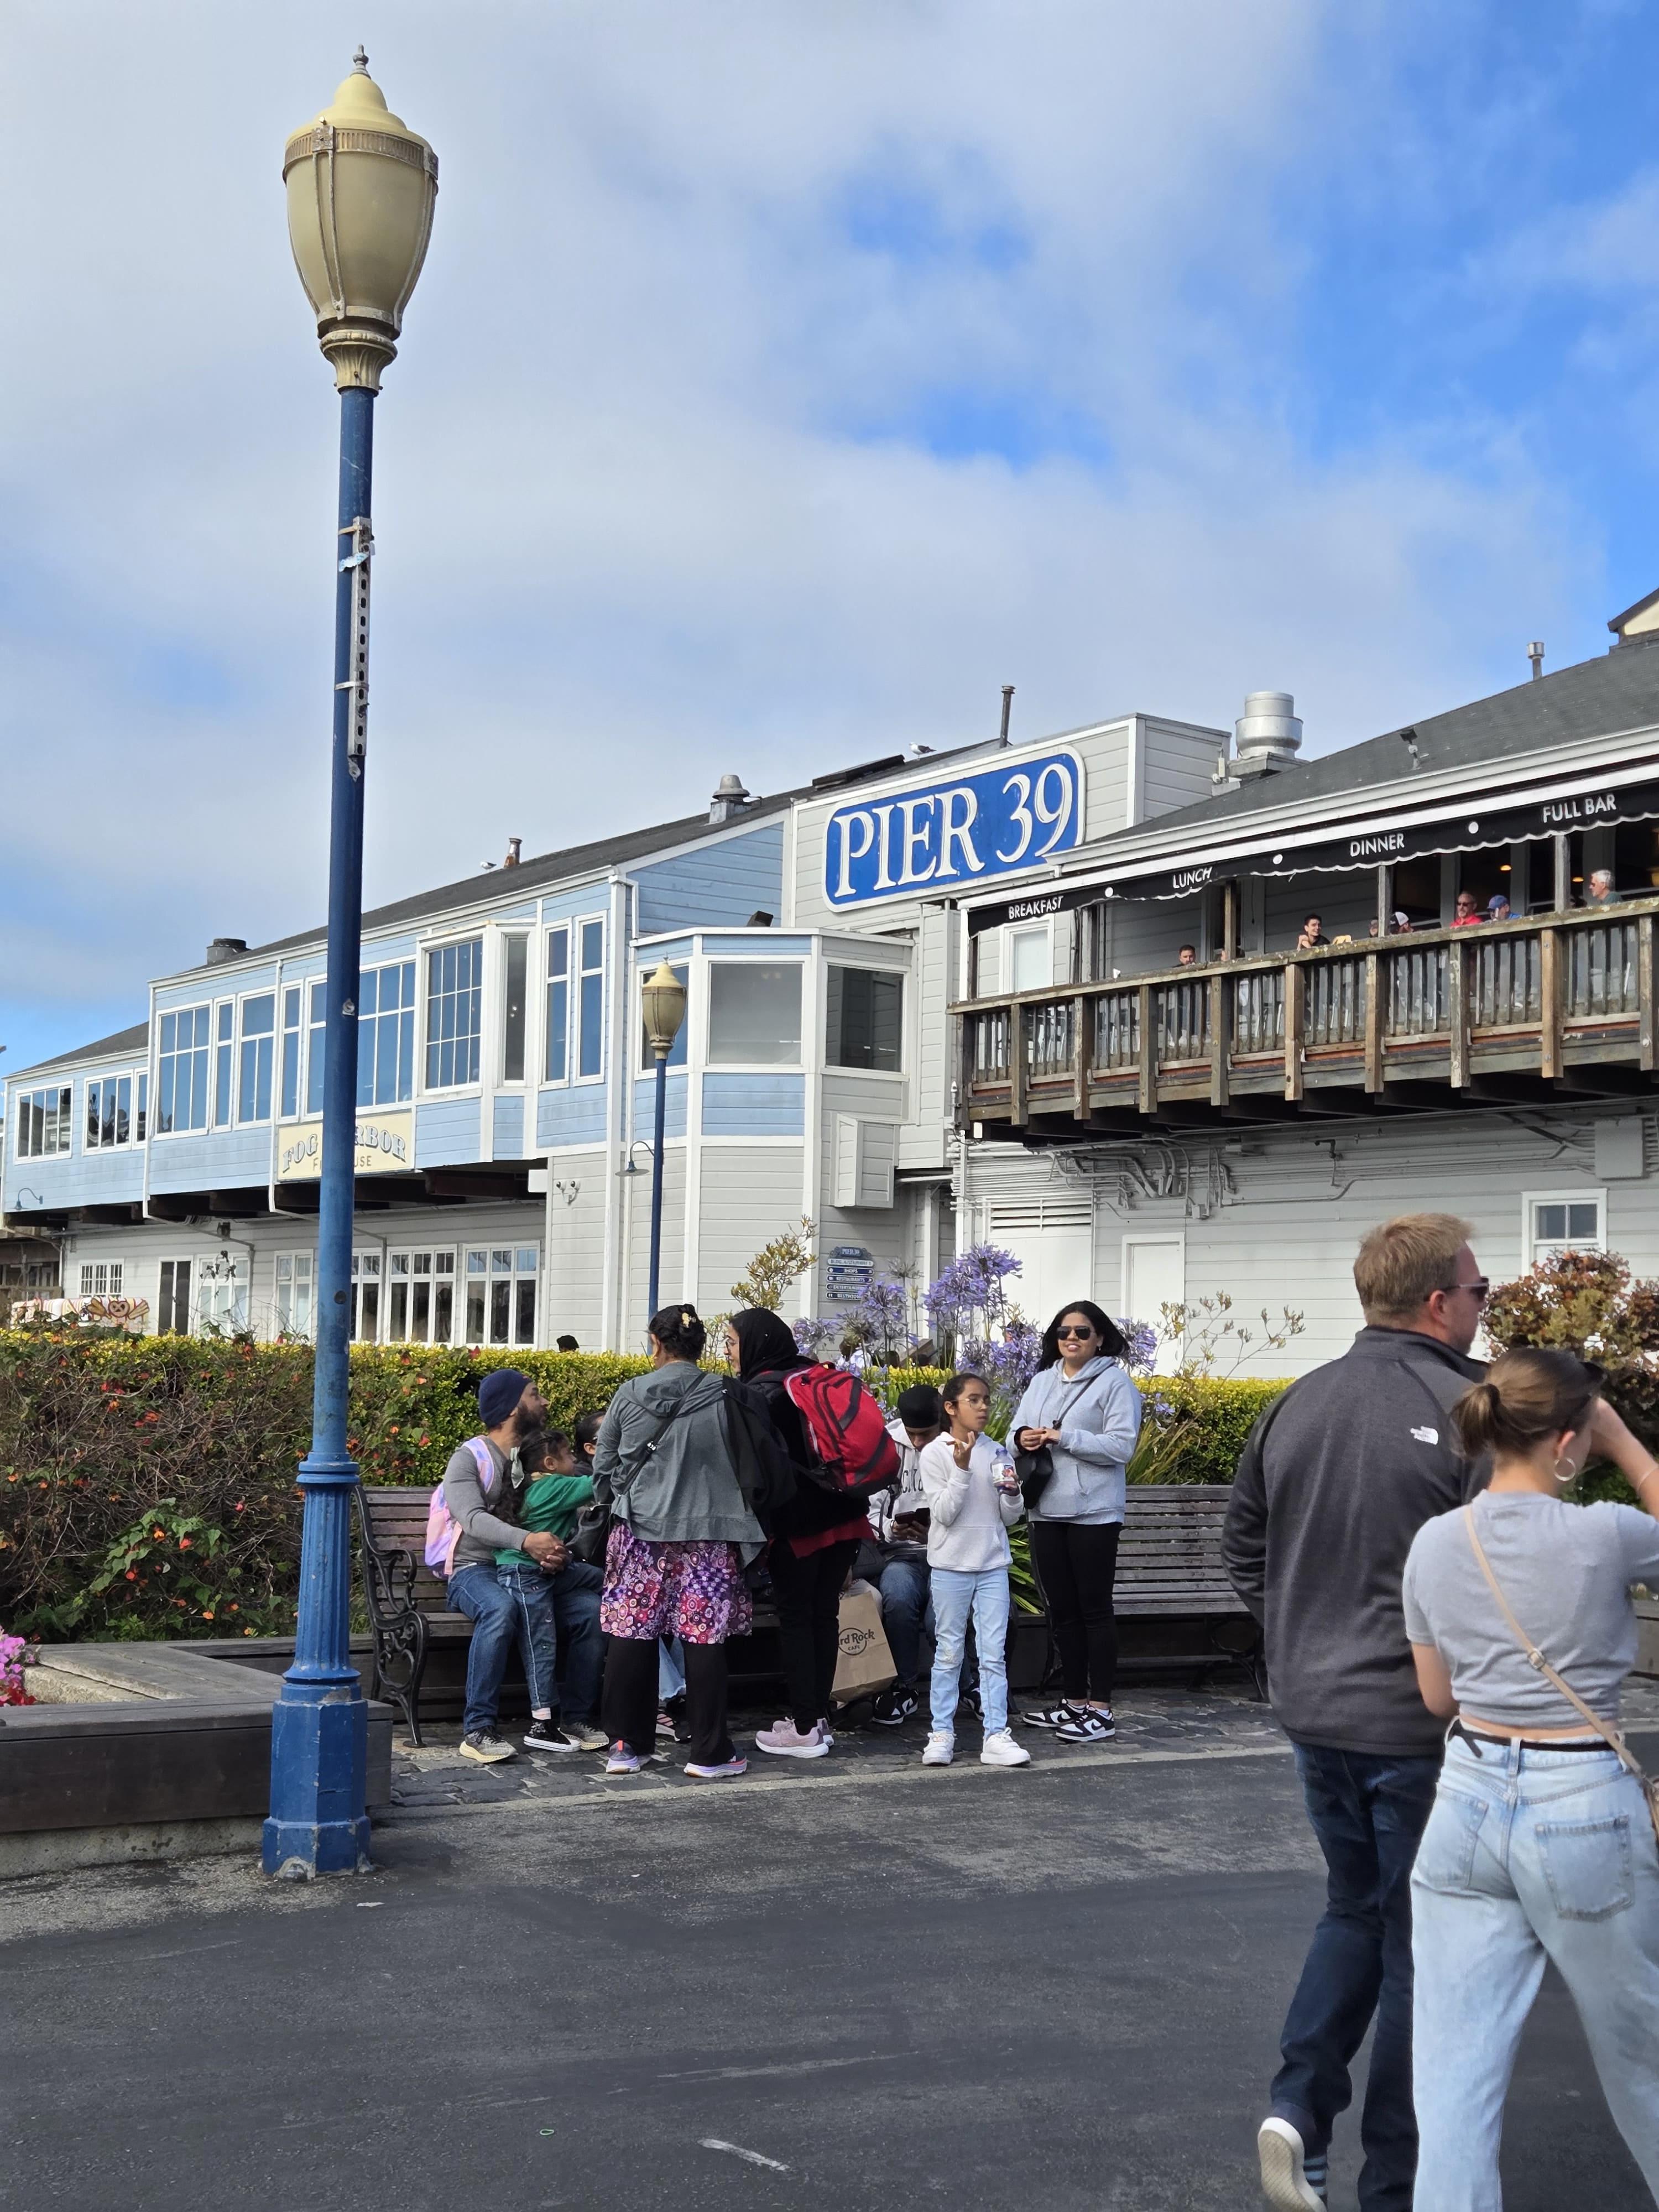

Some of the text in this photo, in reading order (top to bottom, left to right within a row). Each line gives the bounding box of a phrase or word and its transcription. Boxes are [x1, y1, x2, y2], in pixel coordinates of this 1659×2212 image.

[1542, 794, 1617, 823] FULL BAR
[832, 763, 1073, 898] PIER 39
[1350, 833, 1405, 857] DINNER
[1173, 866, 1213, 889] LUNCH
[1008, 895, 1064, 920] BREAKFAST
[283, 1124, 406, 1173] FOG RBOR
[840, 1629, 875, 1645] rd Rock
